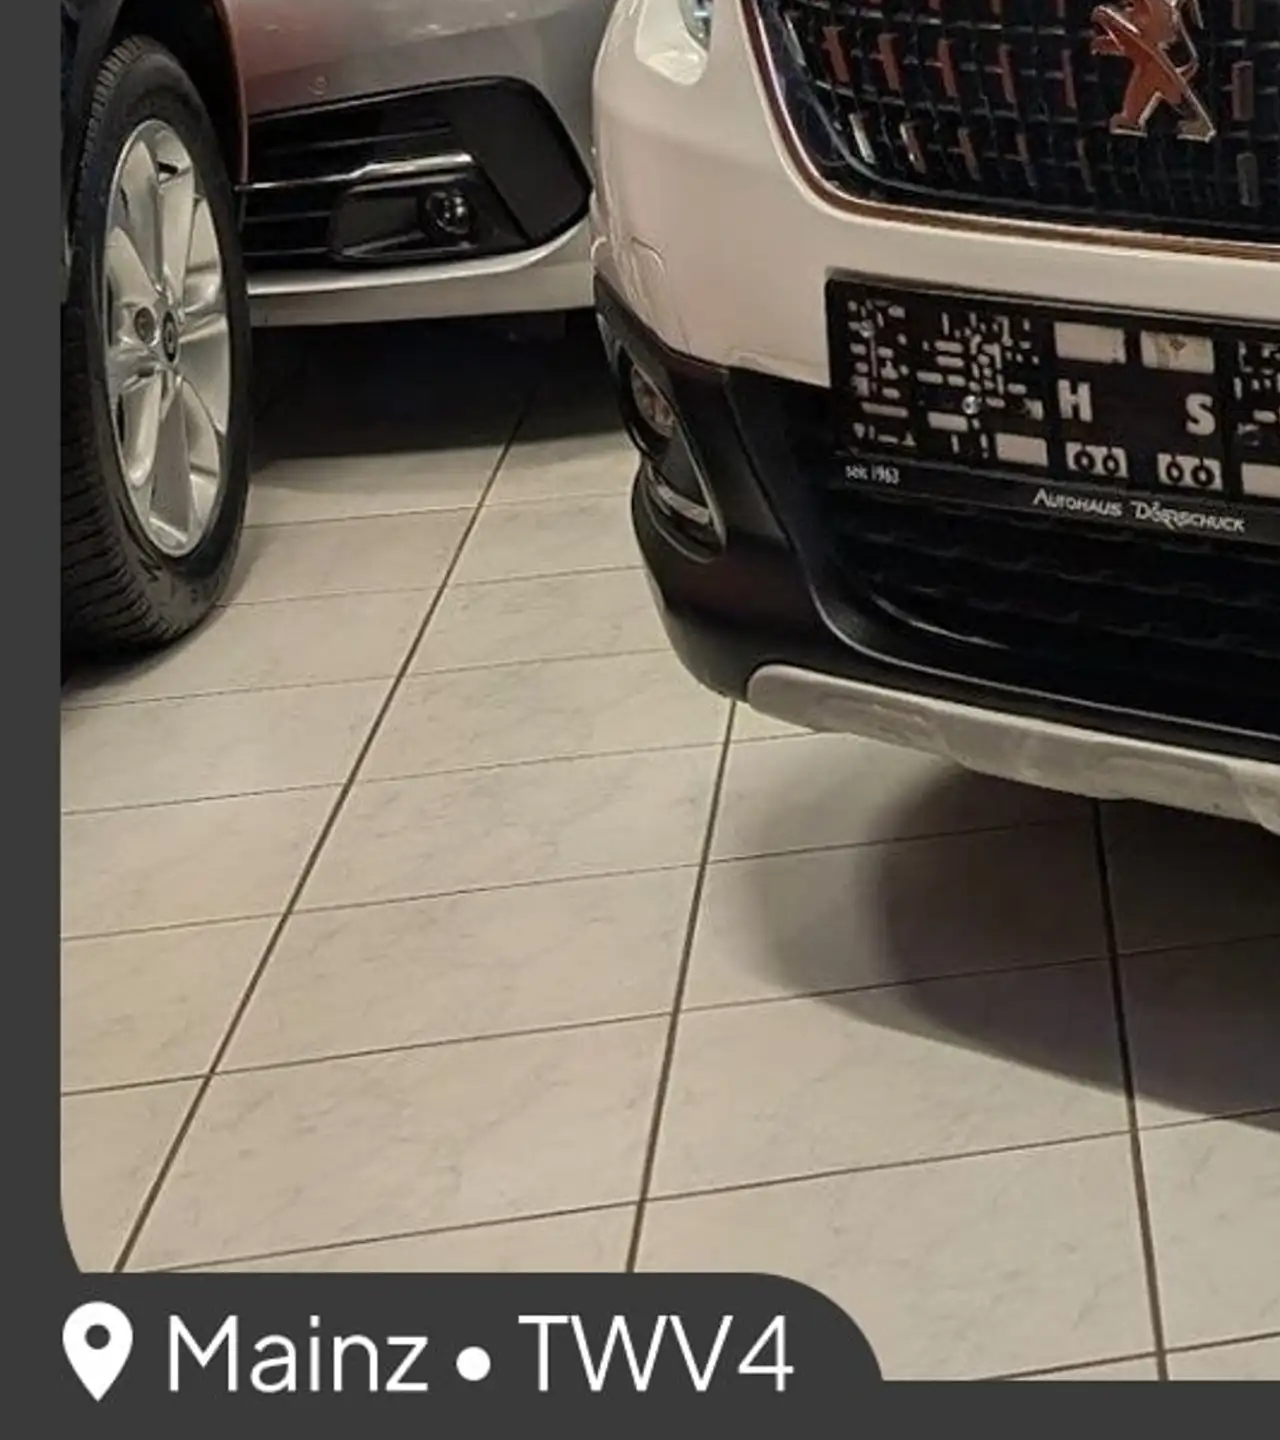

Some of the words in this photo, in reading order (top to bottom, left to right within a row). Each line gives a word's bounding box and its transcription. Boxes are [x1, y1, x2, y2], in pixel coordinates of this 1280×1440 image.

[1056, 378, 1093, 422] H
[1185, 392, 1216, 436] S
[1032, 488, 1123, 518] AUTOHAUS
